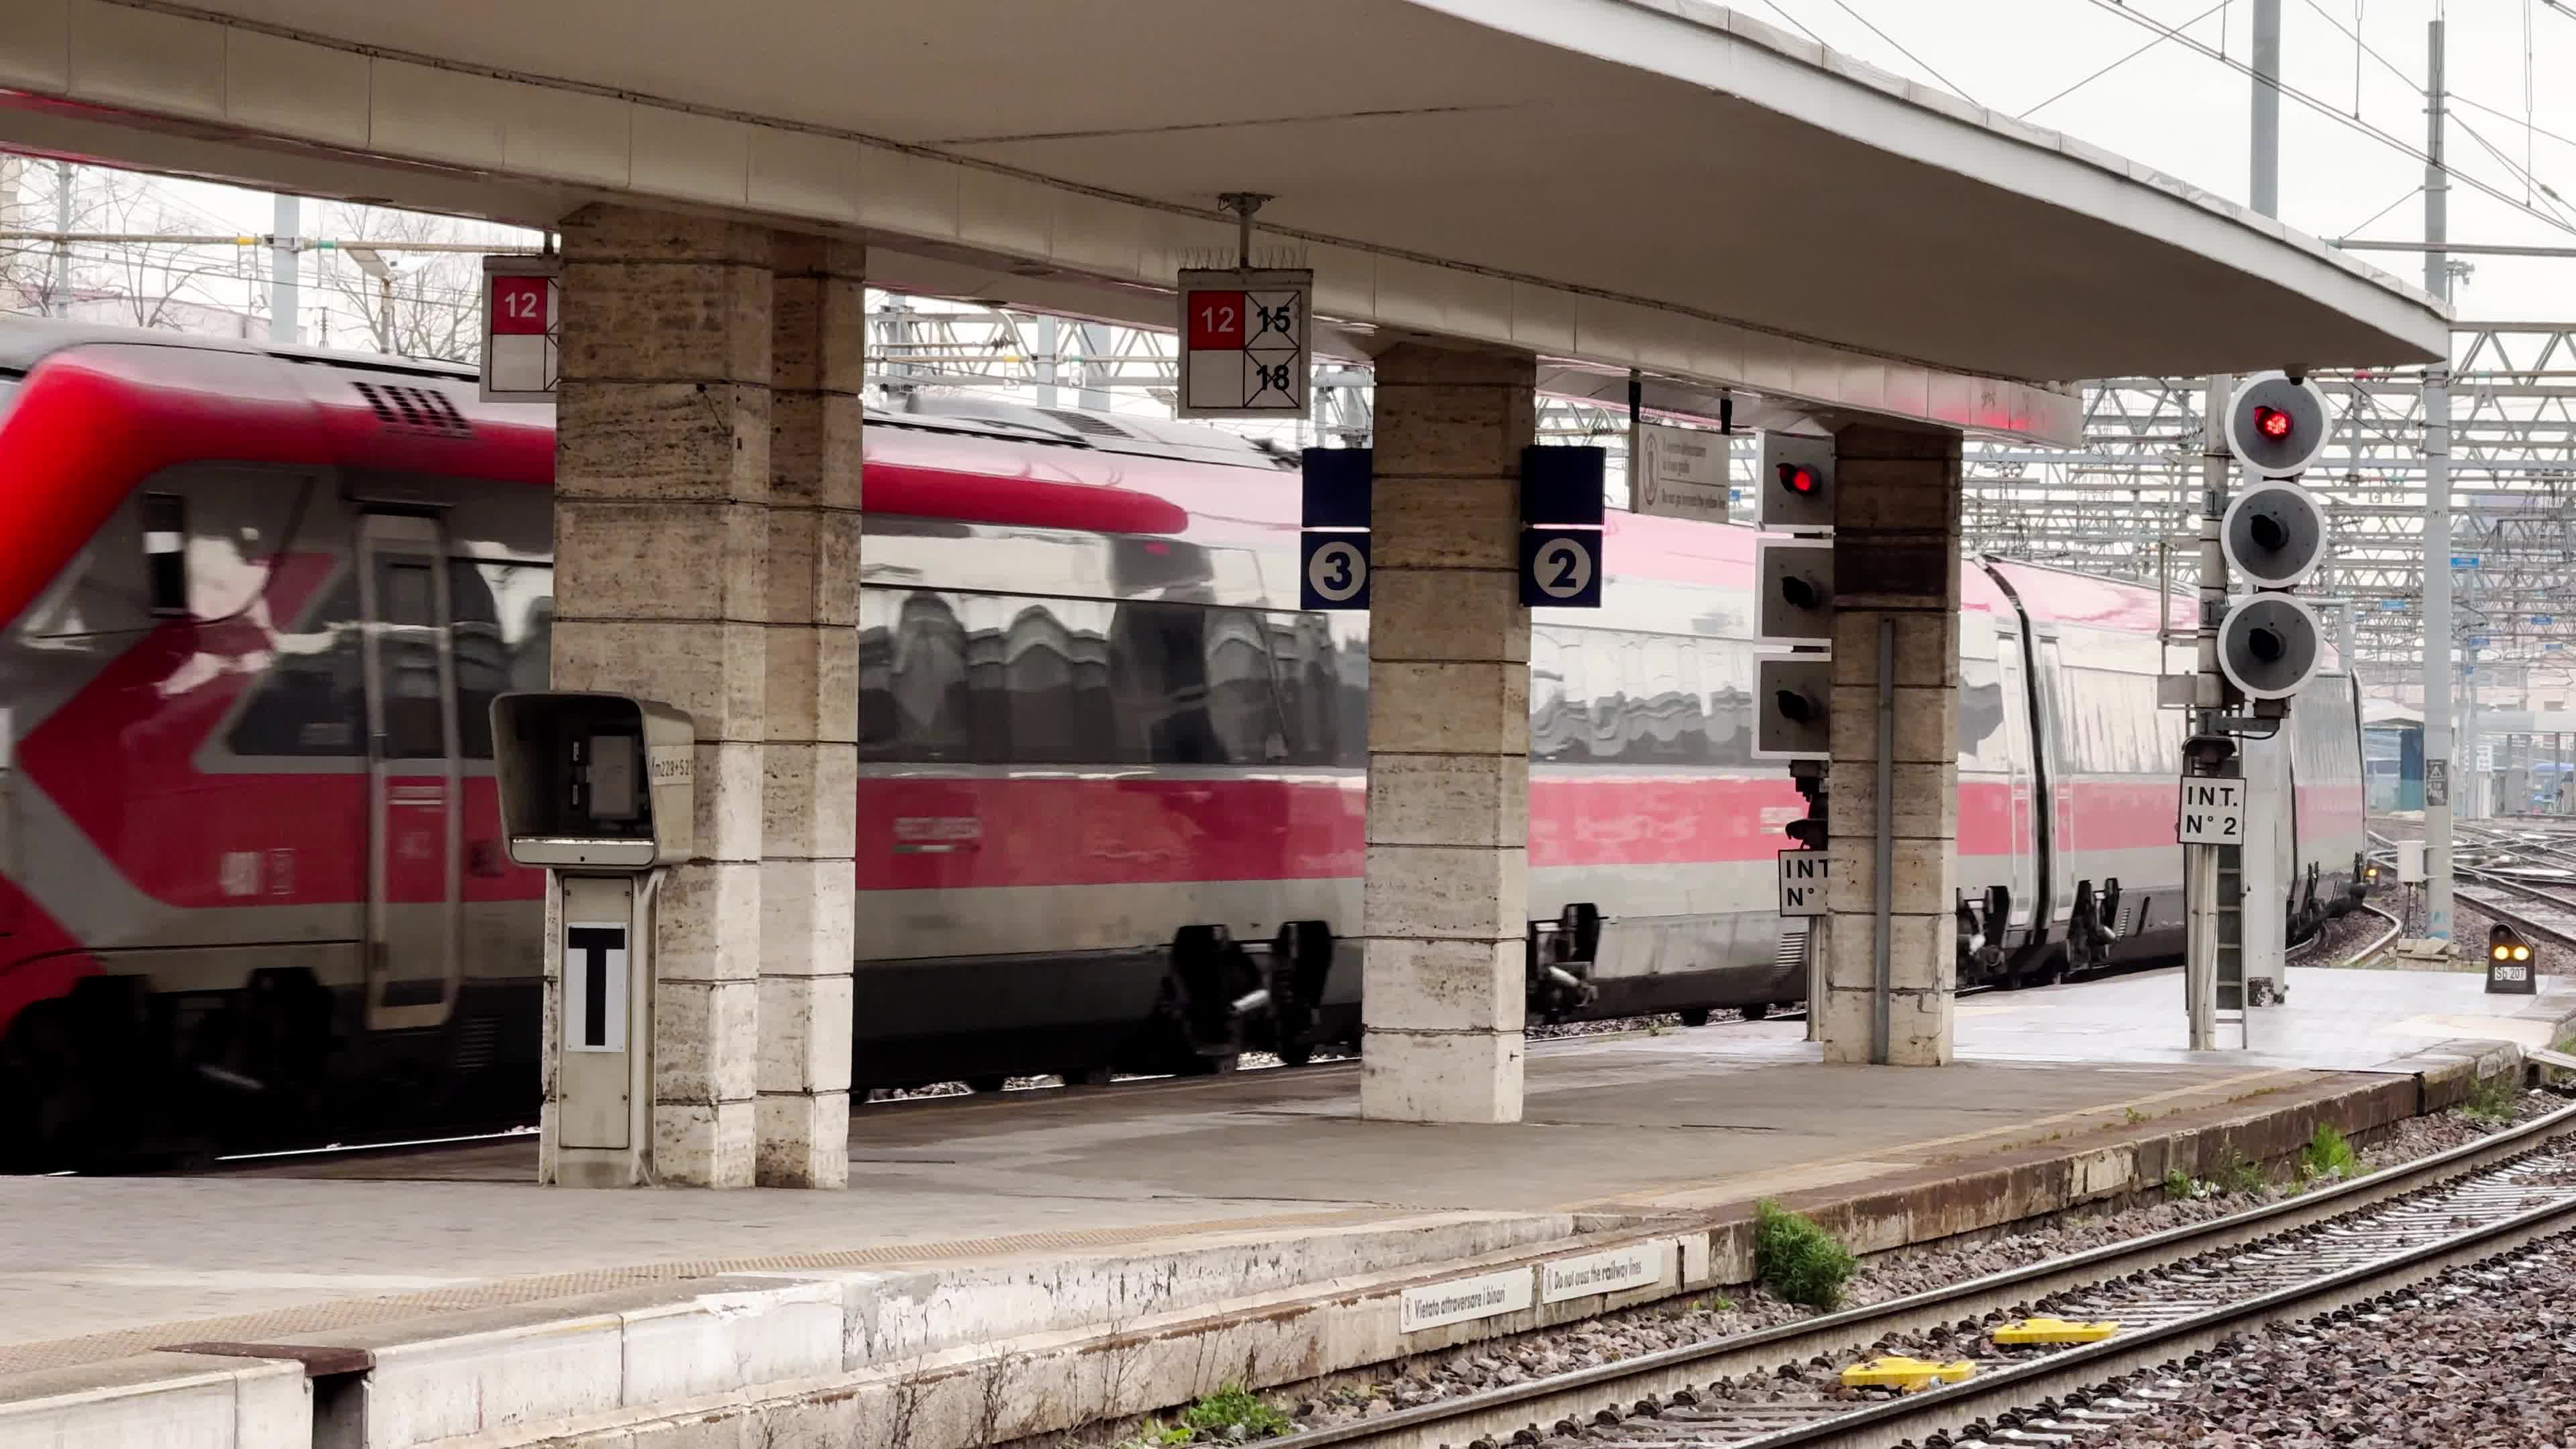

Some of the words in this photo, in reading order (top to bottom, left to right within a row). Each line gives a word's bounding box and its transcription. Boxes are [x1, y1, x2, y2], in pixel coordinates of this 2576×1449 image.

[504, 292, 537, 317] 12
[1201, 306, 1235, 333] 12
[1256, 306, 1291, 333] 15
[1256, 364, 1289, 390] 18
[1323, 551, 1353, 591] 3
[1548, 547, 1577, 588] 2
[2188, 786, 2238, 806] INT.
[2224, 816, 2237, 835] 2
[568, 926, 626, 1046] T
[2510, 968, 2525, 979] 207
[1554, 1271, 1563, 1289] Do
[1564, 1271, 1574, 1287] not
[1574, 1270, 1590, 1286] cross
[1590, 1262, 1601, 1283] the
[1601, 1258, 1628, 1282] railway
[1414, 1298, 1440, 1320] Vietato
[1440, 1291, 1483, 1314] attraversare
[1486, 1283, 1506, 1305] binari
